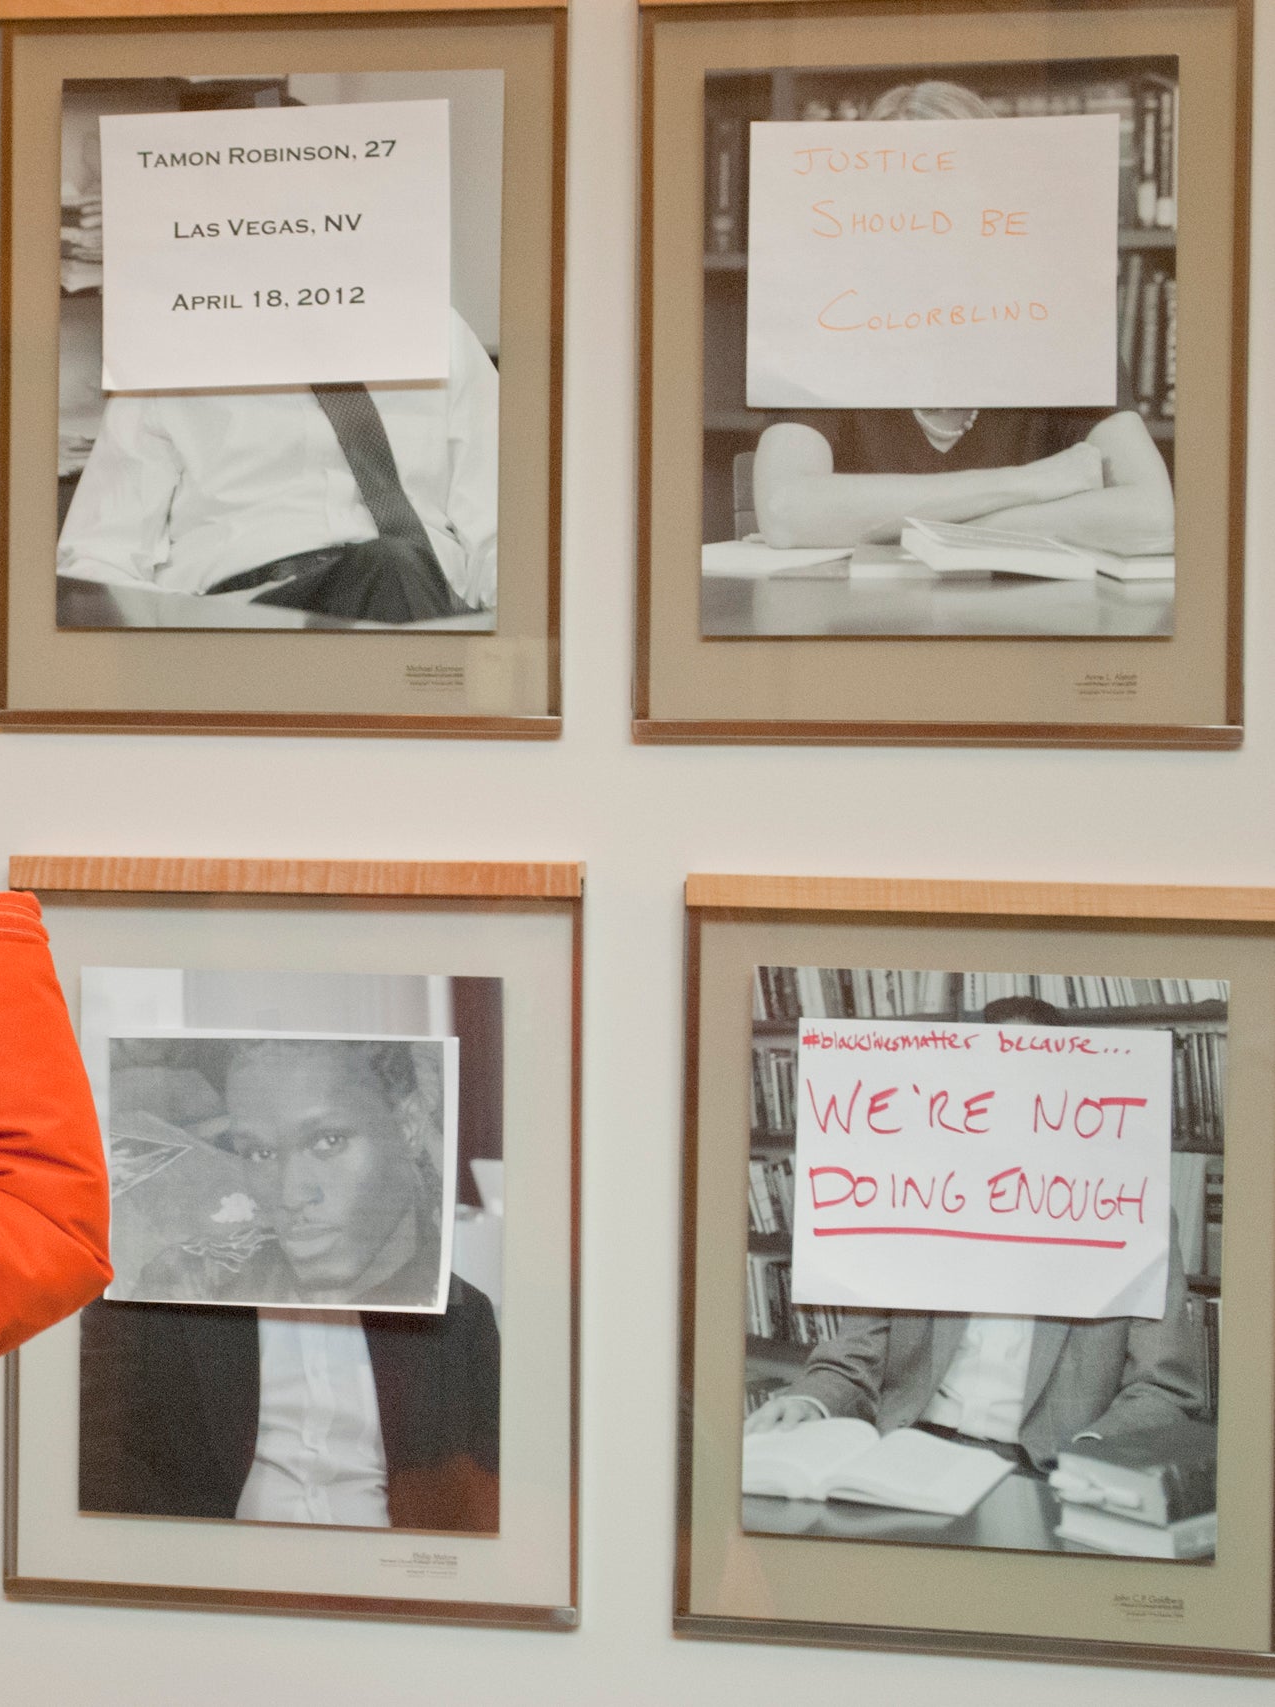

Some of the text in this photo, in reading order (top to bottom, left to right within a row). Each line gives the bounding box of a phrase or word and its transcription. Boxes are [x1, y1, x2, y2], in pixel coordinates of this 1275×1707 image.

[136, 139, 397, 169] TAMON ROBINSON, 27
[793, 148, 957, 176] JUSTICE
[174, 213, 363, 239] LAS VEGAS, NV
[811, 199, 1030, 239] SHOULD BE
[171, 286, 366, 312] APRIL 18, 2012
[817, 288, 1049, 332] COLORBLIND
[806, 1078, 1148, 1139] WE'RE NOT
[808, 1166, 1149, 1224] DOING ENOUGH
